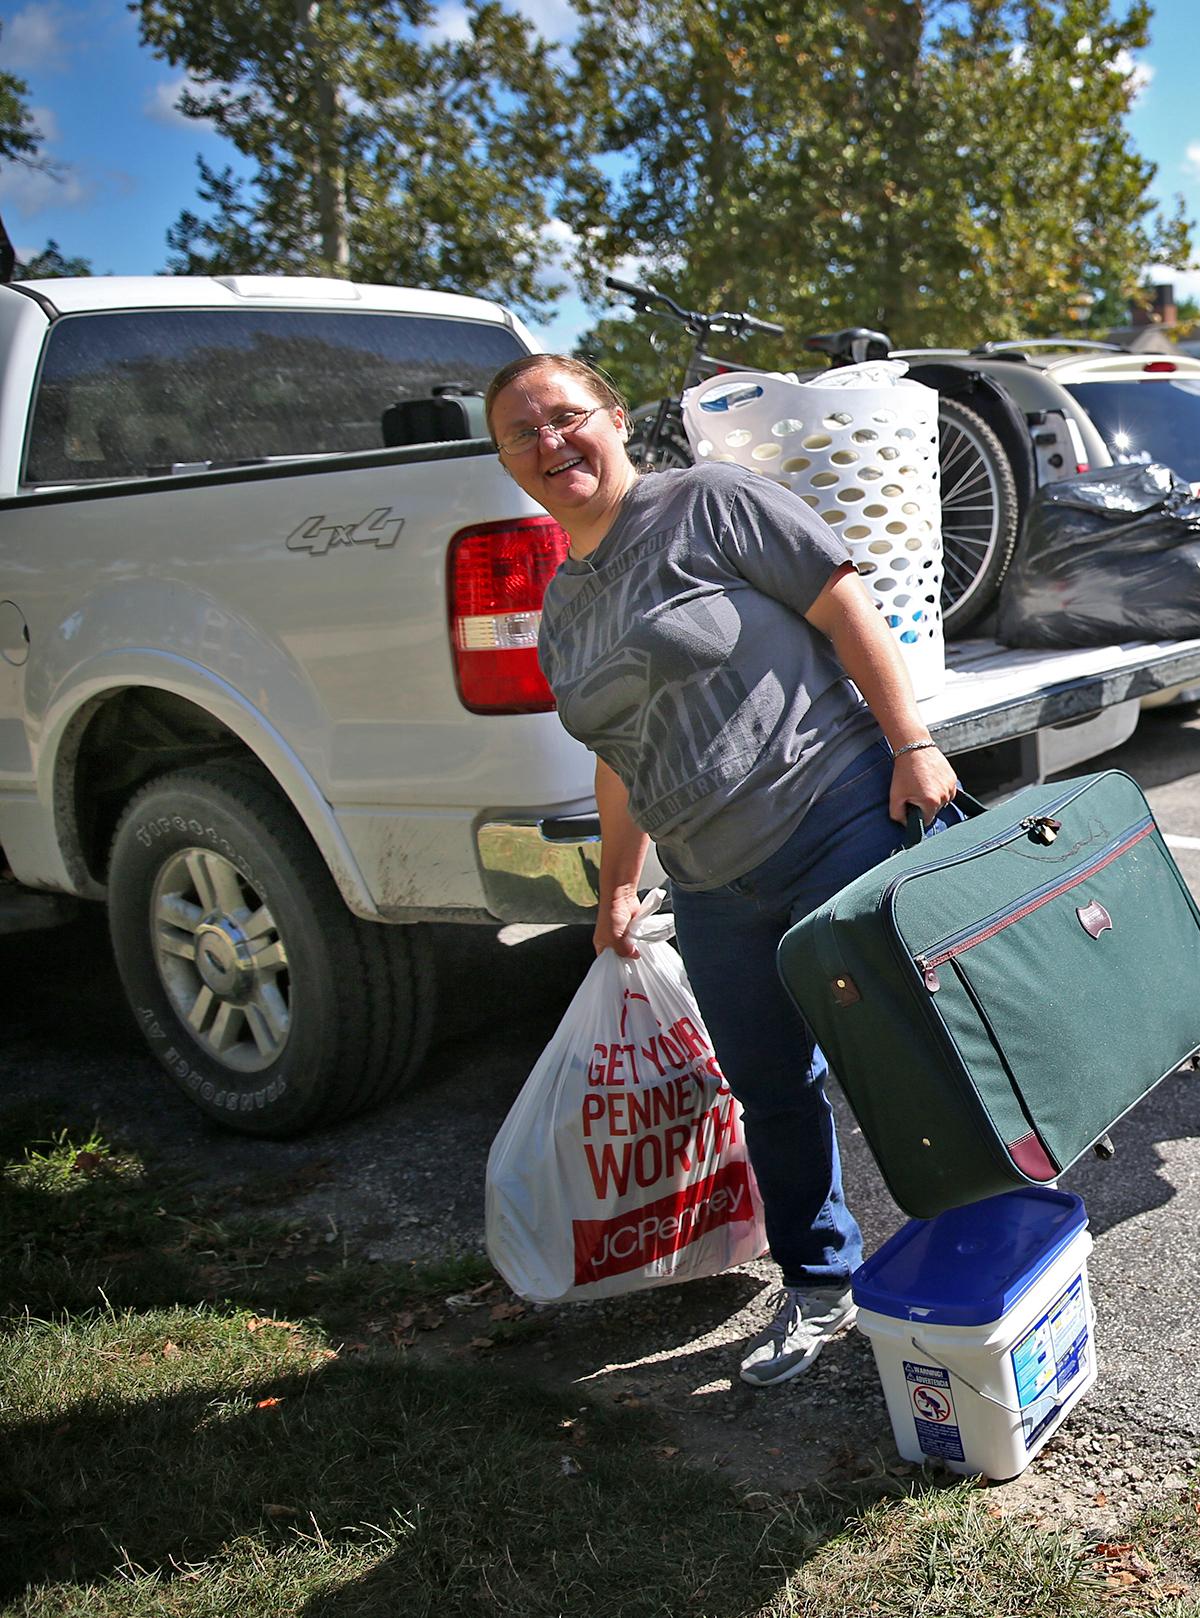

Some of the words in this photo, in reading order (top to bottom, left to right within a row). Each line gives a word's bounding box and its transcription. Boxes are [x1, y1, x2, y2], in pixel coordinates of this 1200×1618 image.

[286, 506, 405, 557] 4x4
[588, 1043, 640, 1086] GET
[641, 1016, 710, 1077] YOUR
[584, 1097, 737, 1200] WORTH
